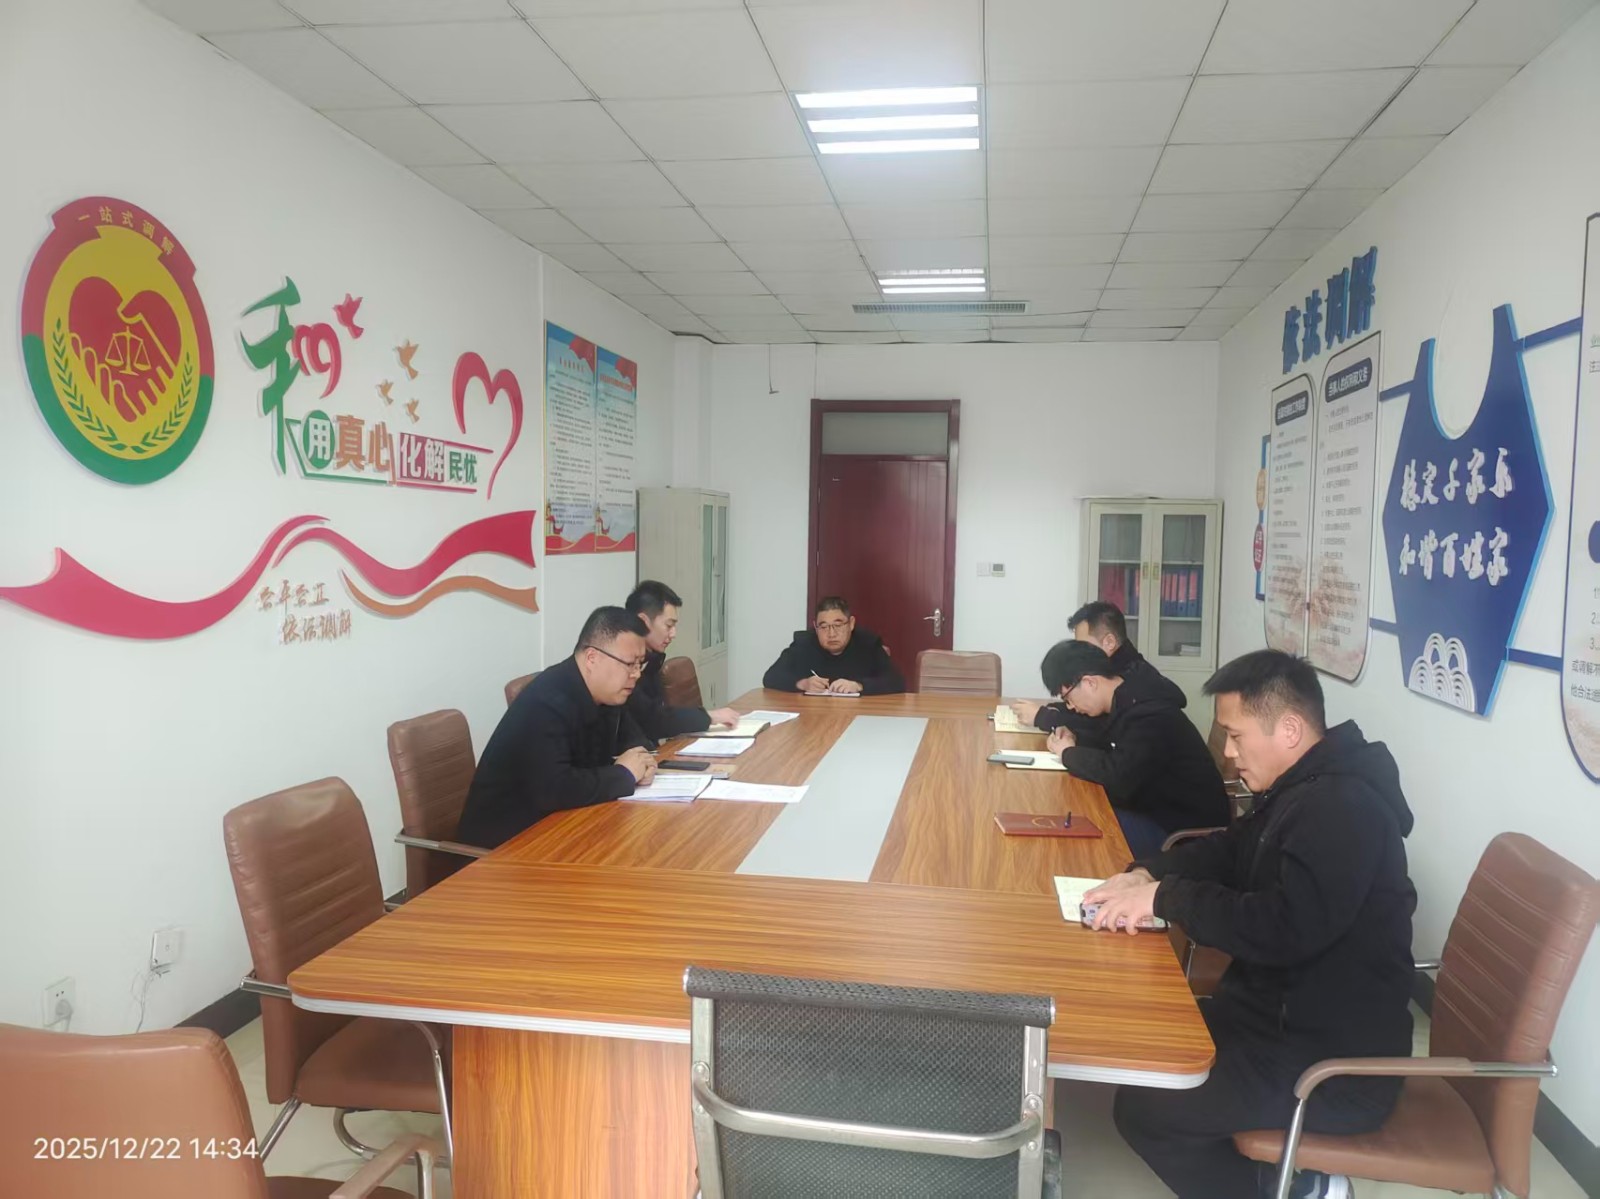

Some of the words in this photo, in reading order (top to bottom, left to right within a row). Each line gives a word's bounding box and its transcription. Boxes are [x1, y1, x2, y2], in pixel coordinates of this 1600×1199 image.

[77, 205, 175, 256] 一站式调解
[306, 413, 478, 484] 用真心化解民忧
